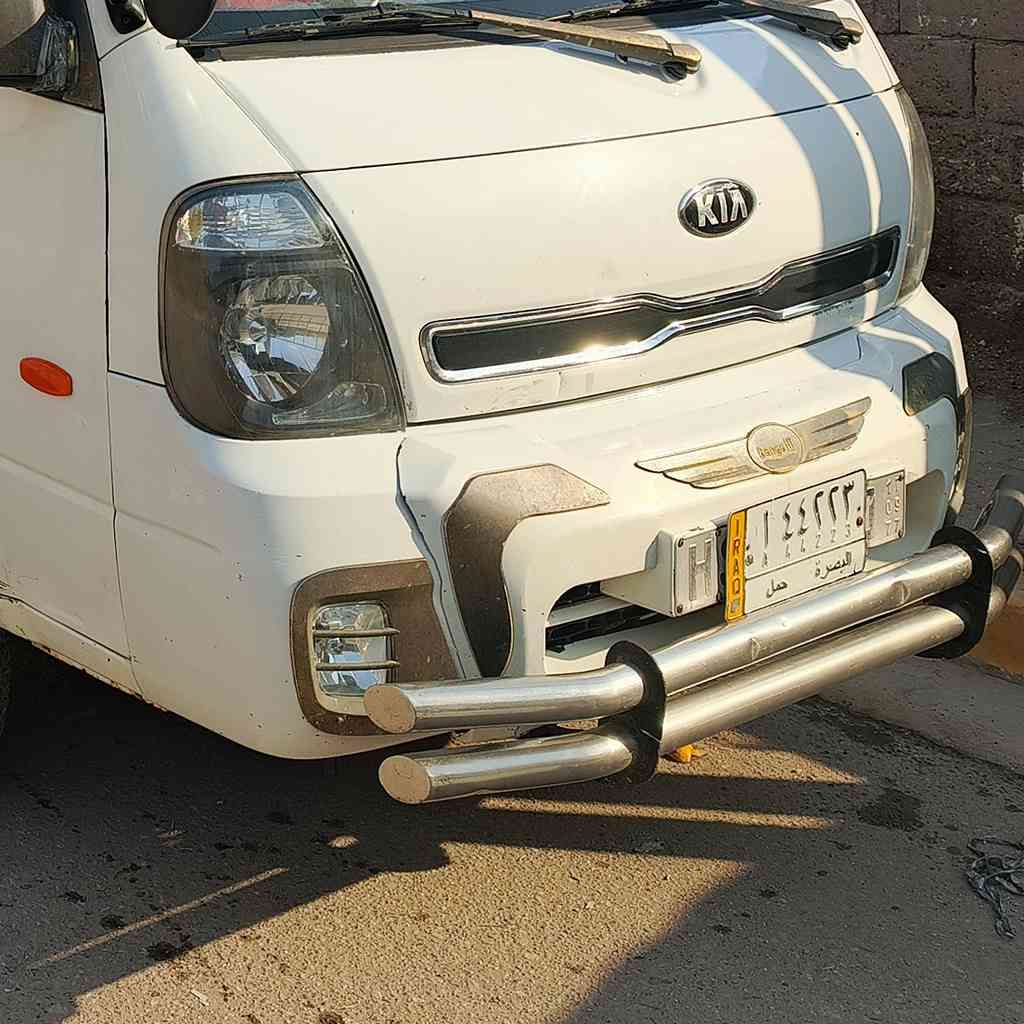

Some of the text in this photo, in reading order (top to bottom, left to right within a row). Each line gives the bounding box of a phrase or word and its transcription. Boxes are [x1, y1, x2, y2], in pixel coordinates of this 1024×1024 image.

[694, 188, 748, 227] KIA
[815, 551, 853, 579] البصرة
[766, 579, 789, 599] حمل
